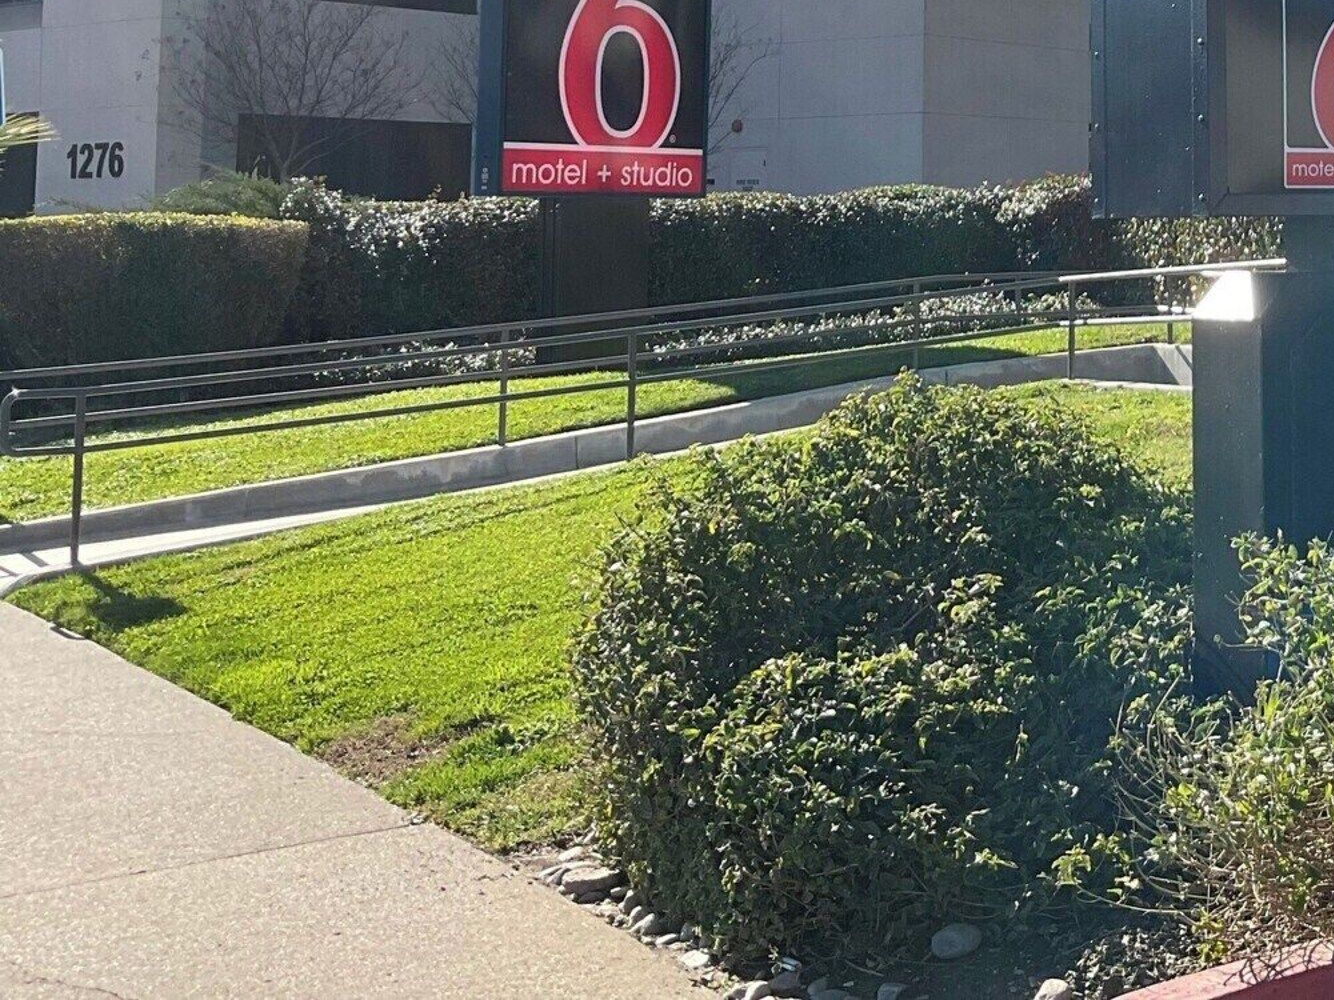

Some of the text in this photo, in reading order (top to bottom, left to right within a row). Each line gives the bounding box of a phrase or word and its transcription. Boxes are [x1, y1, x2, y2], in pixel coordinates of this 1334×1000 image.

[67, 141, 124, 179] 1276
[511, 158, 588, 185] motel
[620, 161, 693, 187] studio
